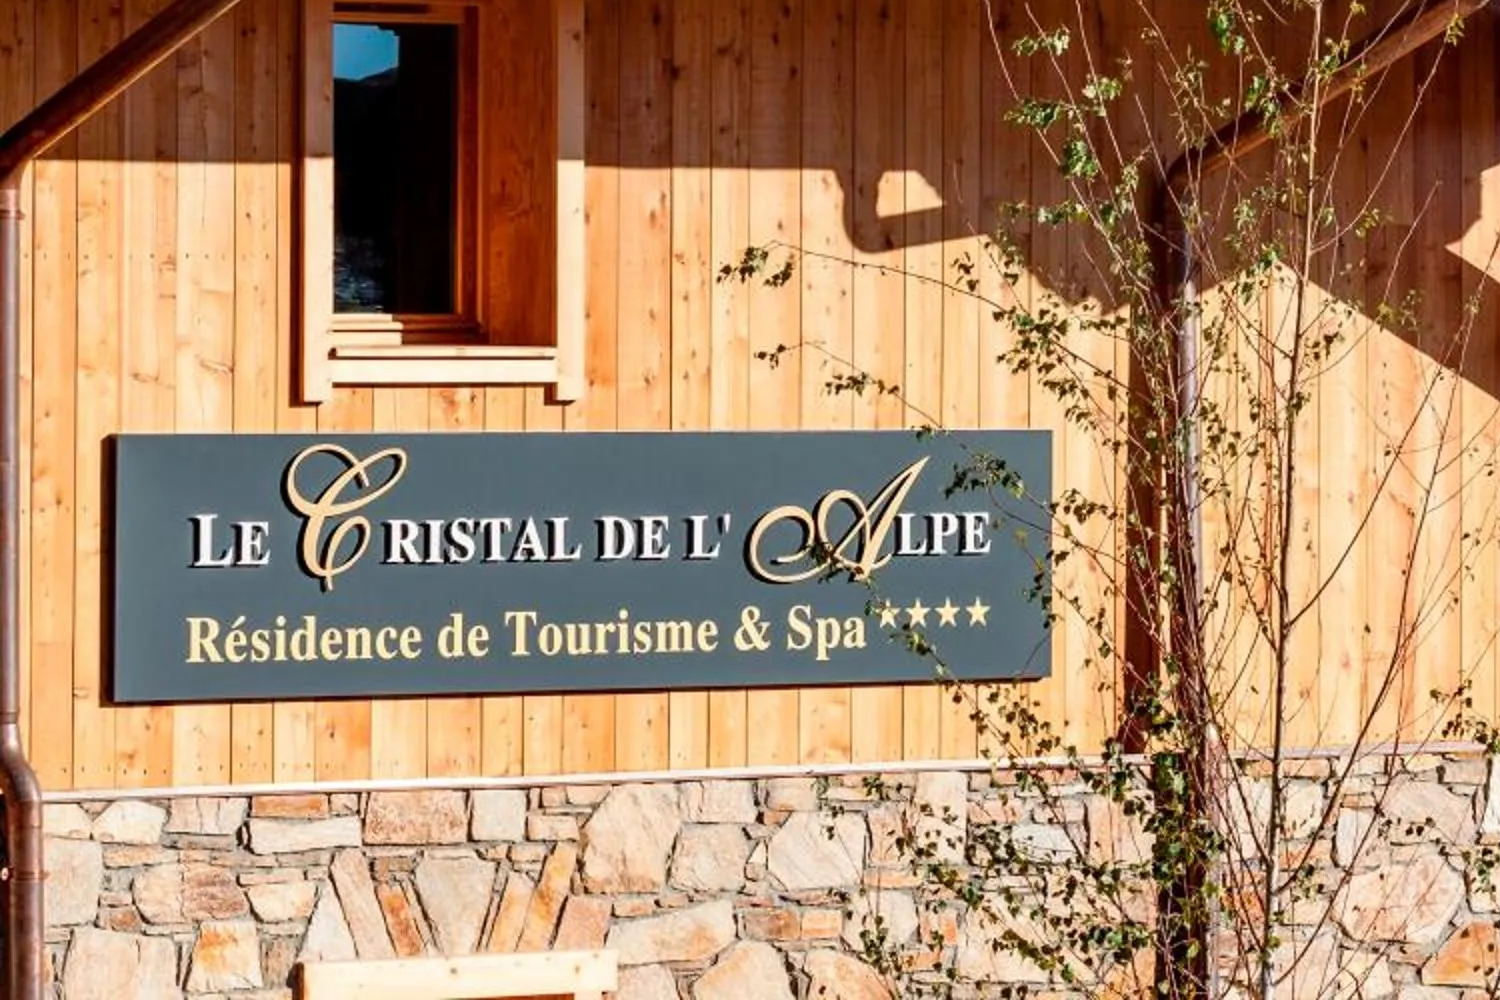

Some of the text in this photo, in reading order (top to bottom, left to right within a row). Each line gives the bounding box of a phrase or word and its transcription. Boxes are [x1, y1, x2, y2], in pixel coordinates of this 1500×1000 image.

[185, 604, 867, 664] Résidence de Tourisme & Spa
